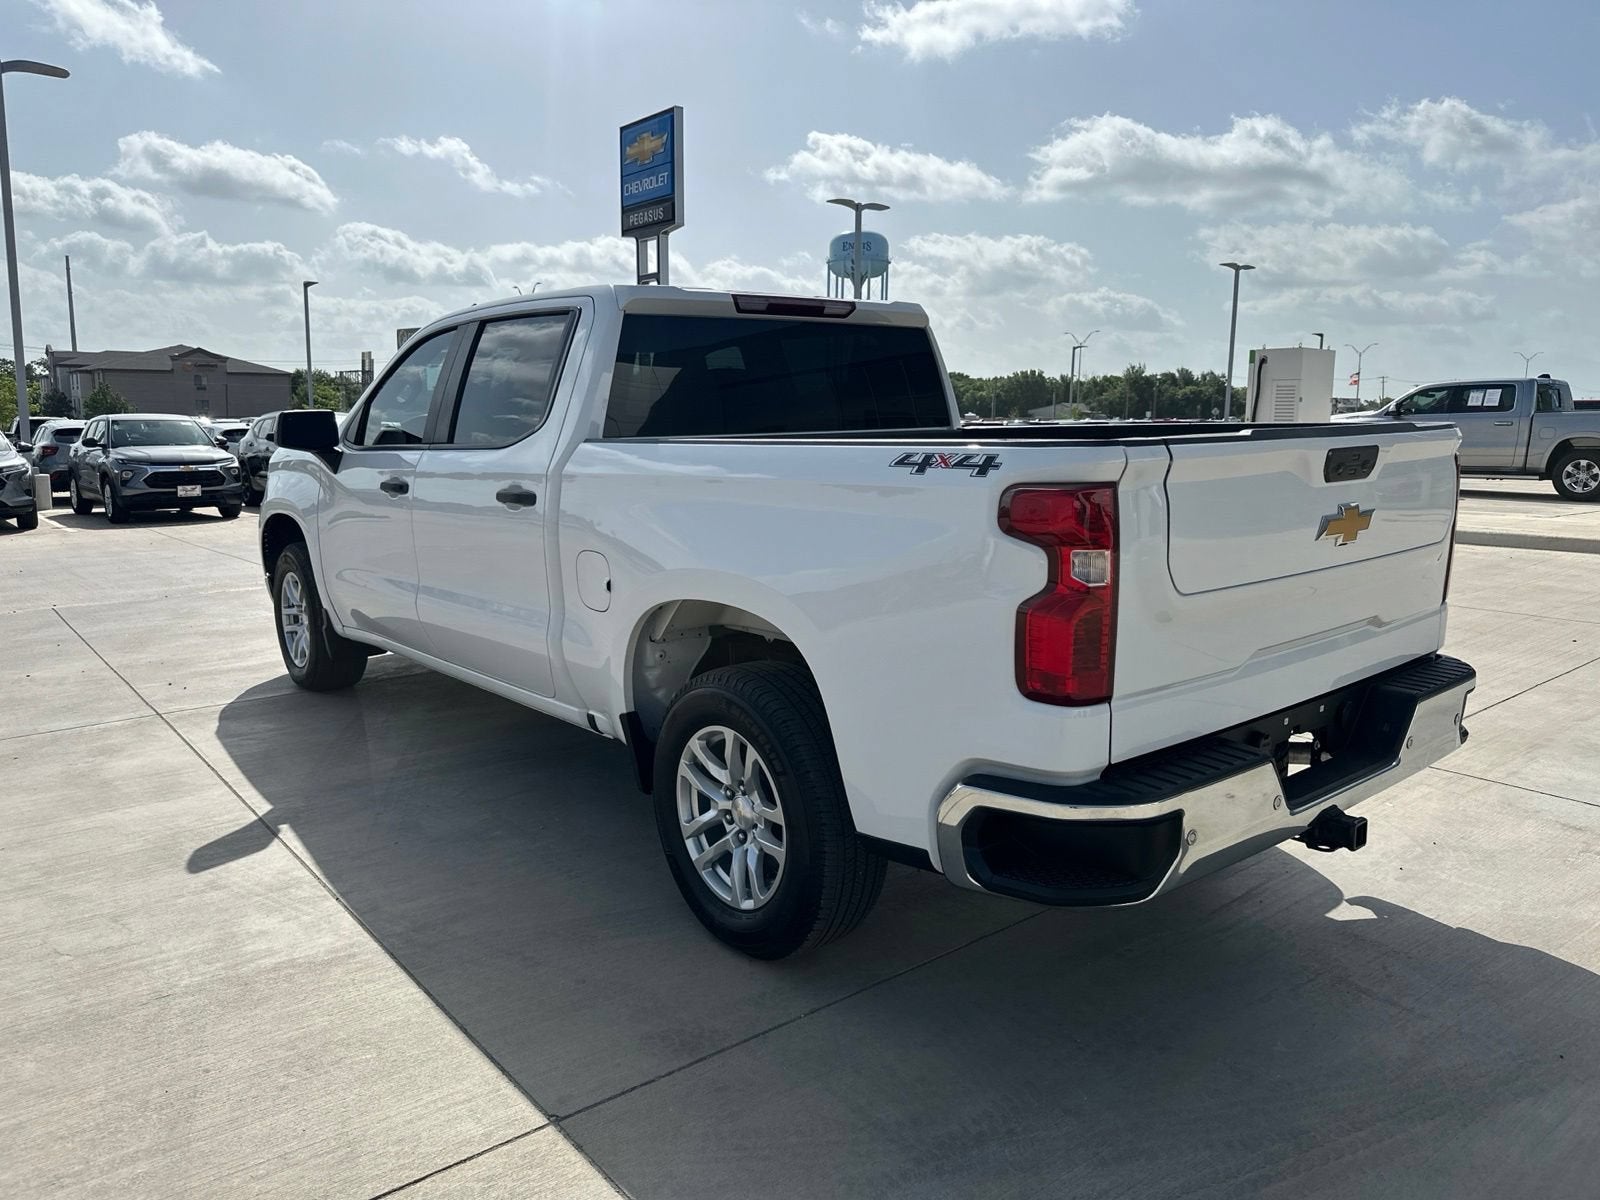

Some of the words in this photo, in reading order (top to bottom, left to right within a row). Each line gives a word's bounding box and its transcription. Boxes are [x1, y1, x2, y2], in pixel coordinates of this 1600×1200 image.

[624, 172, 669, 196] CHEVROLET
[629, 207, 664, 226] PEGASUS
[842, 241, 872, 251] ENIS
